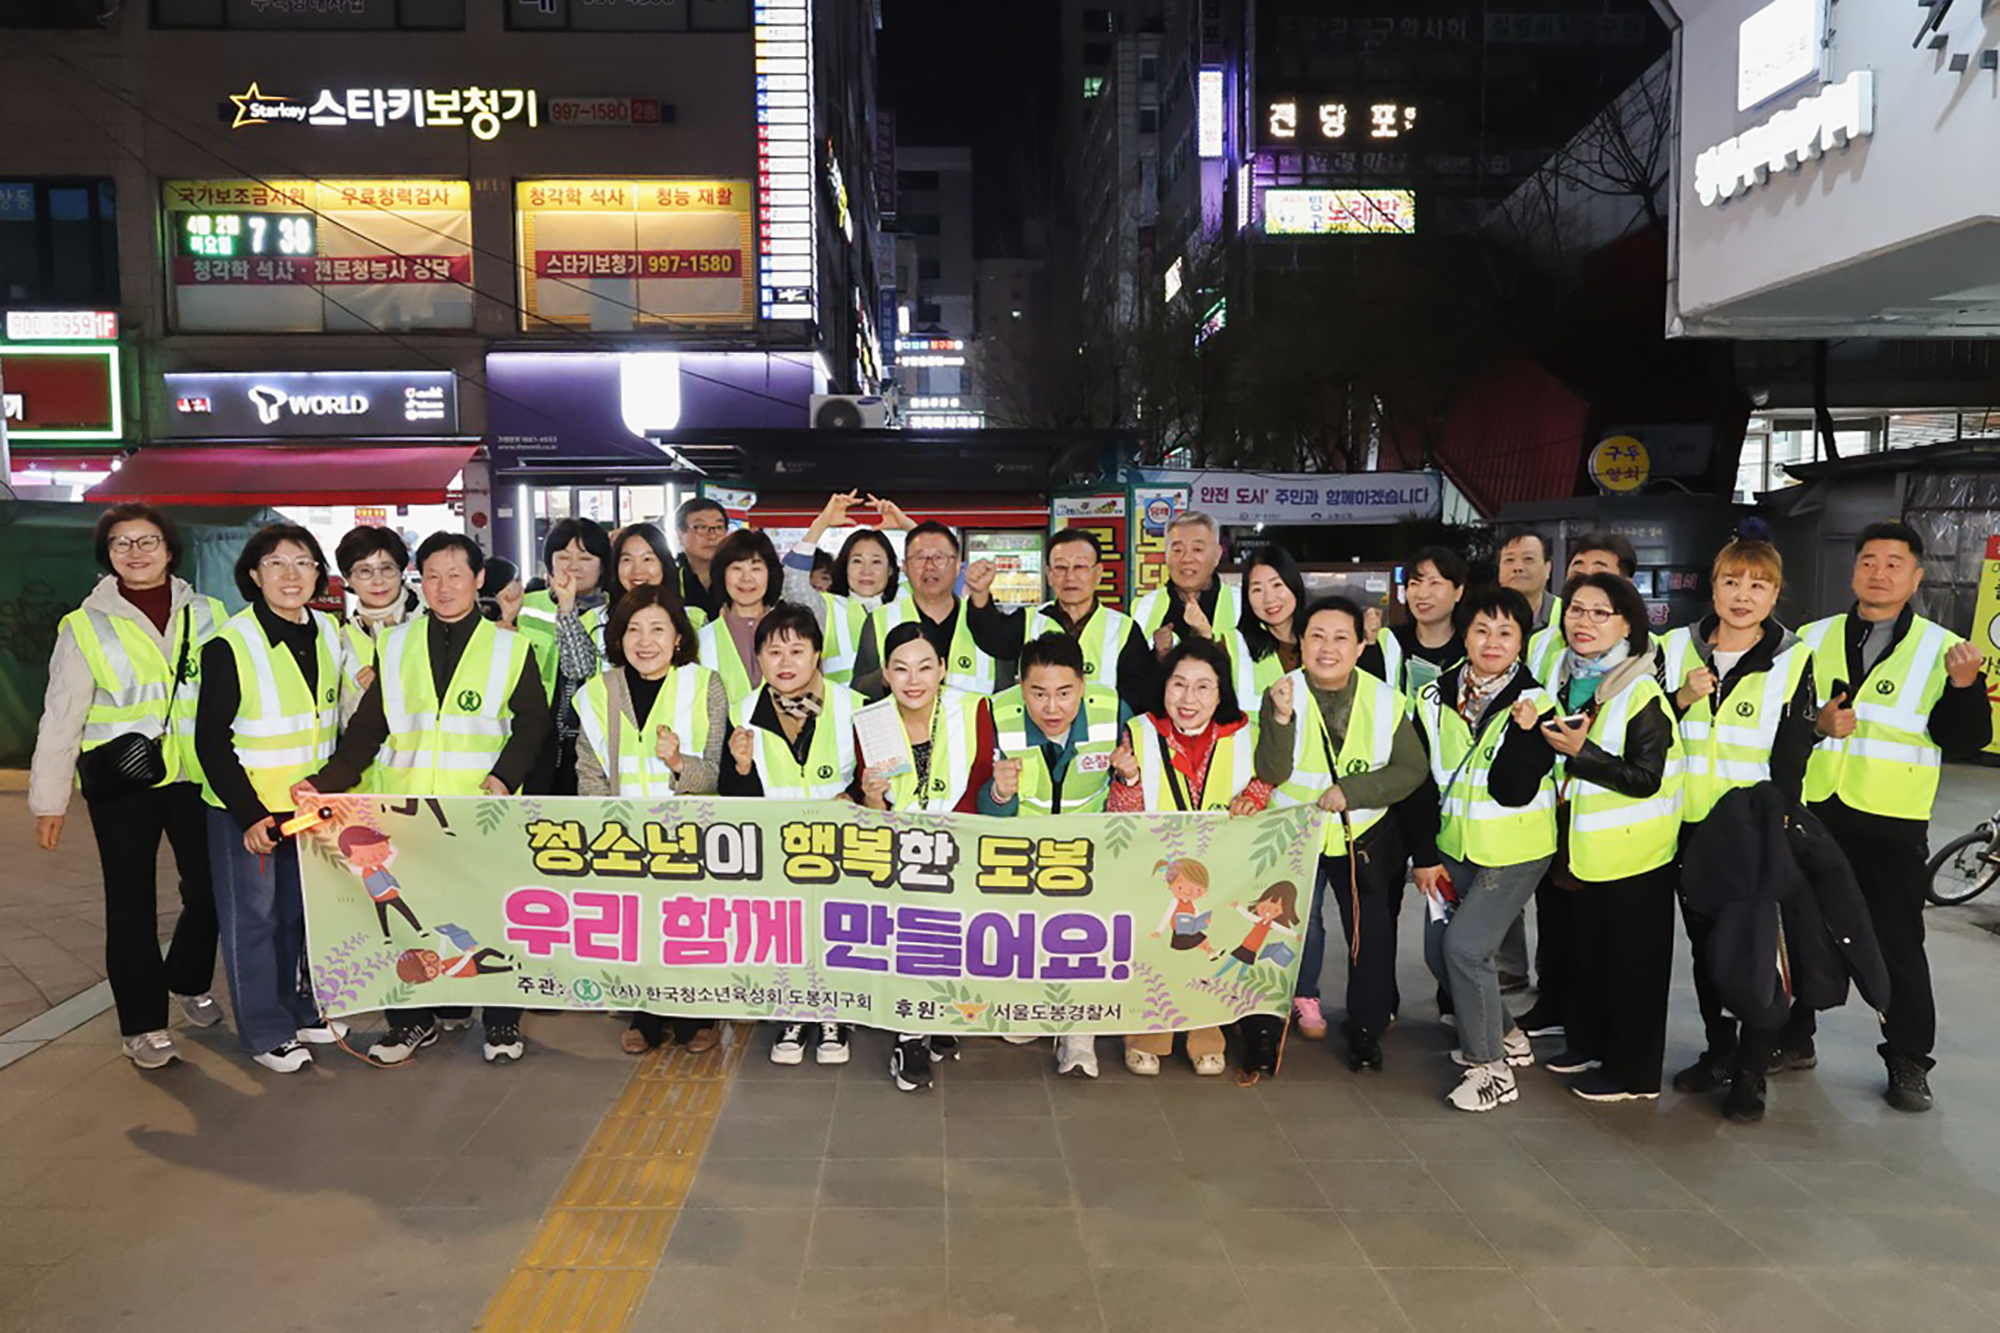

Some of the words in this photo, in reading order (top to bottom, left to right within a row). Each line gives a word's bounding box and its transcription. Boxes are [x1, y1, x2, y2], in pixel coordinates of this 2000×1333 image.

[249, 102, 306, 123] Starkey
[308, 88, 538, 141] 스타키보청기
[550, 102, 629, 121] 997-1580
[178, 187, 305, 206] 국가보조금지원
[528, 187, 582, 206] 청각학
[589, 187, 625, 206] 석사
[656, 187, 691, 206] 청능
[698, 187, 733, 206] 재활
[1327, 198, 1400, 224] 노래방
[193, 259, 249, 281] 청각학
[256, 260, 295, 281] 석사
[413, 258, 451, 280] 상담
[545, 253, 643, 275] 스타키보청기
[648, 254, 732, 273] 997-1580
[288, 395, 369, 415] WORLD
[1605, 445, 1640, 462] 구두
[1200, 486, 1230, 504] 안전
[1275, 488, 1320, 506] 주민과
[1325, 486, 1430, 506] 함께하겠습니다
[526, 819, 763, 881] 청소년이
[781, 821, 960, 893] 행복한
[976, 834, 1095, 896] 도봉
[505, 888, 641, 964] 우리
[662, 895, 803, 966] 함께
[821, 899, 1136, 983] 만들어요!
[610, 983, 642, 1000] (사)
[646, 985, 784, 1006] 한국청소년육성회
[789, 989, 873, 1012] 도봉지구회
[993, 1002, 1122, 1022] 서울도봉경찰서
